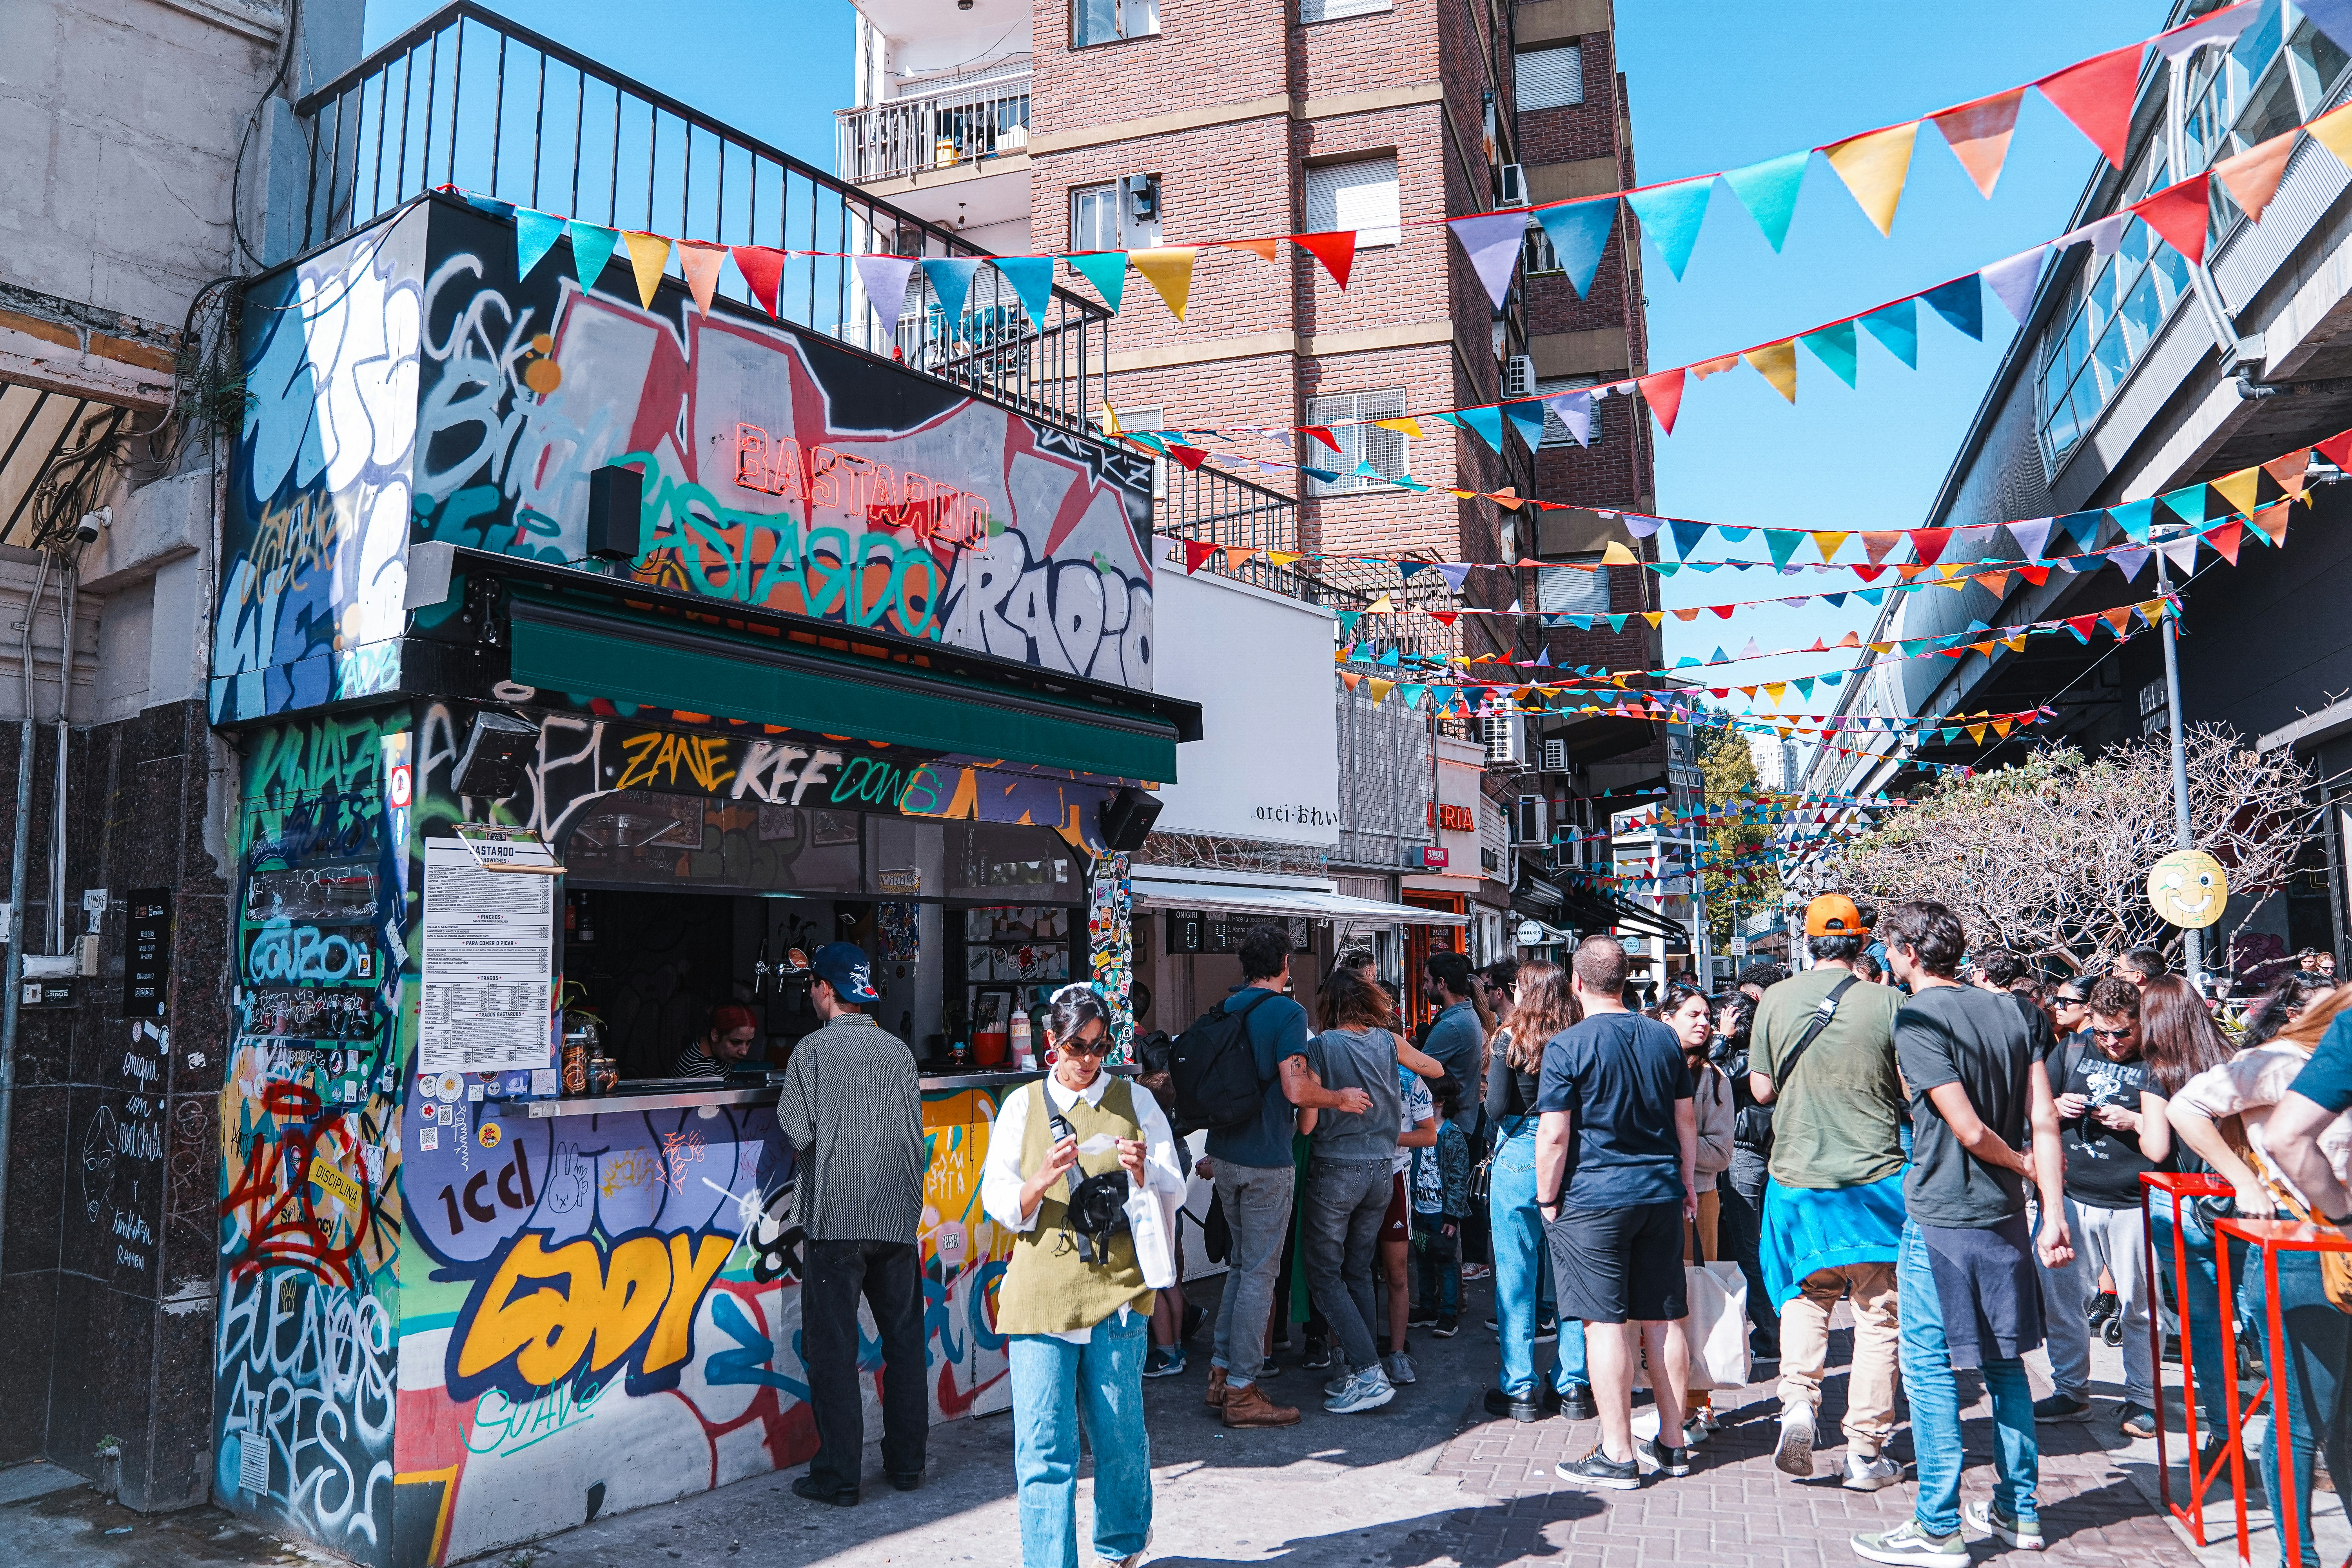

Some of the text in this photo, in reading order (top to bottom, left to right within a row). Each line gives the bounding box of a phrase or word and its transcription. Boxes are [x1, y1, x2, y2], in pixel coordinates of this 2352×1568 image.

[734, 422, 989, 553] BASTARDO
[616, 731, 736, 792] ZANE
[1256, 804, 1289, 822] orei
[1298, 805, 1338, 826] おれい
[87, 895, 105, 908] TIMBRE
[1125, 1027, 1130, 1036] R
[316, 1164, 358, 1205] DISCIPLINA
[117, 1244, 144, 1272] RAMEN
